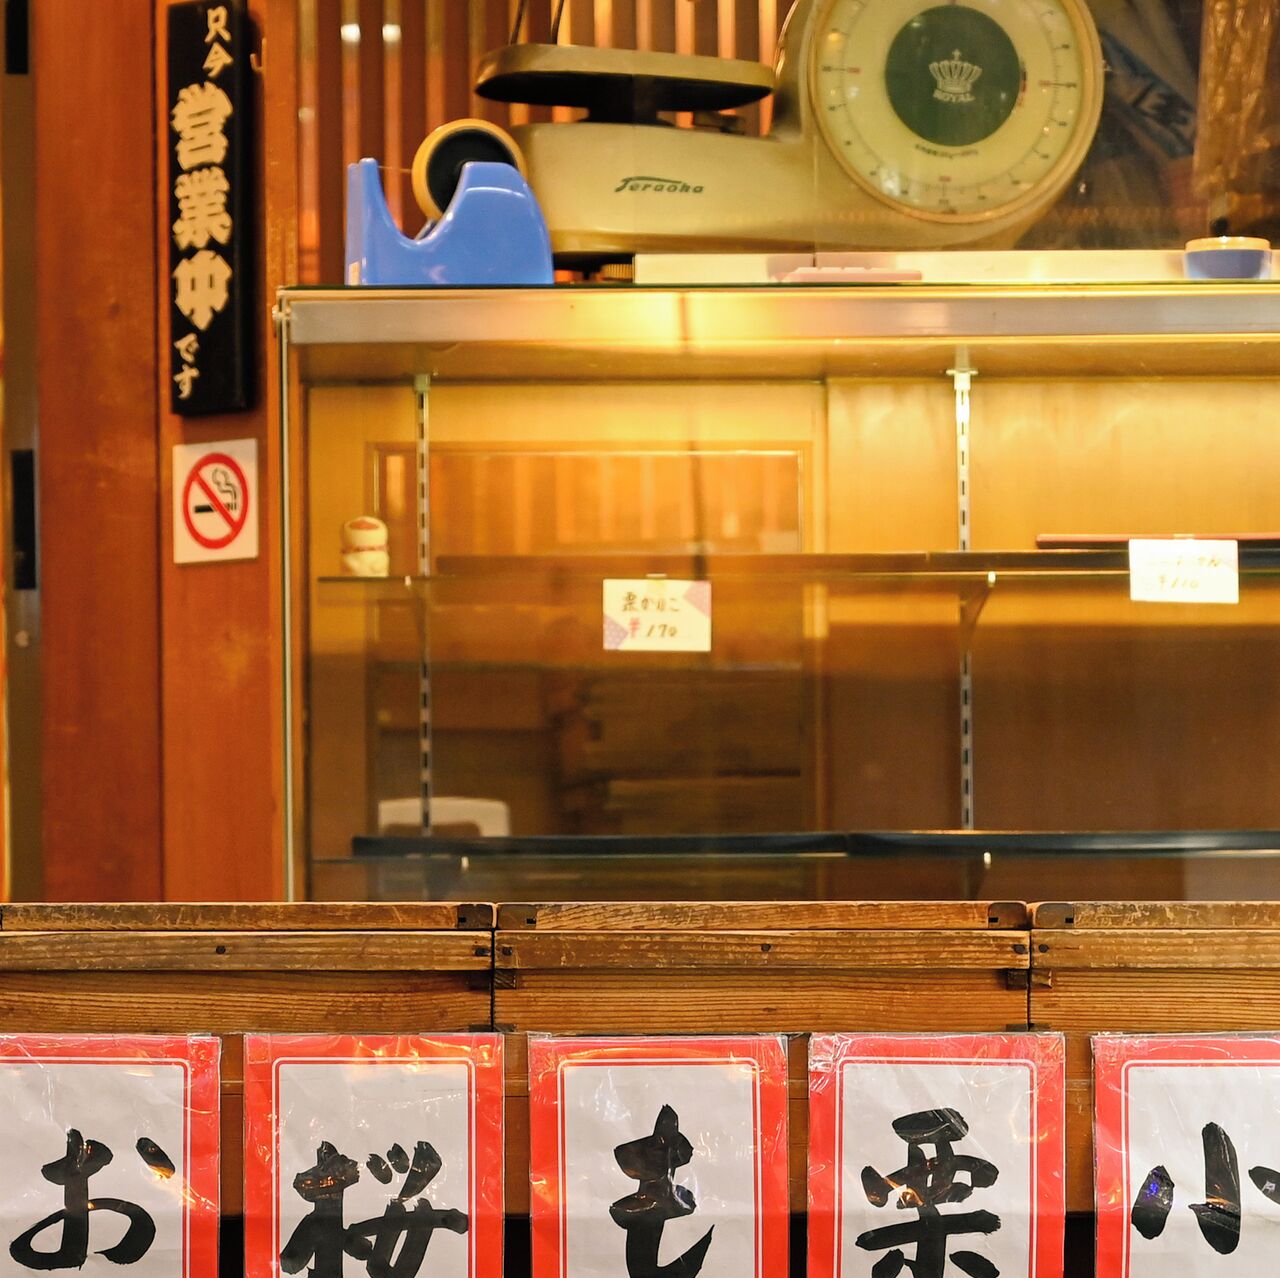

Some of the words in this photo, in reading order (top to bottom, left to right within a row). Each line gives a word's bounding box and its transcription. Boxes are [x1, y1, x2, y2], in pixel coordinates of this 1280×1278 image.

[170, 5, 234, 399] 只今営業中です
[614, 175, 705, 193] Teraoka
